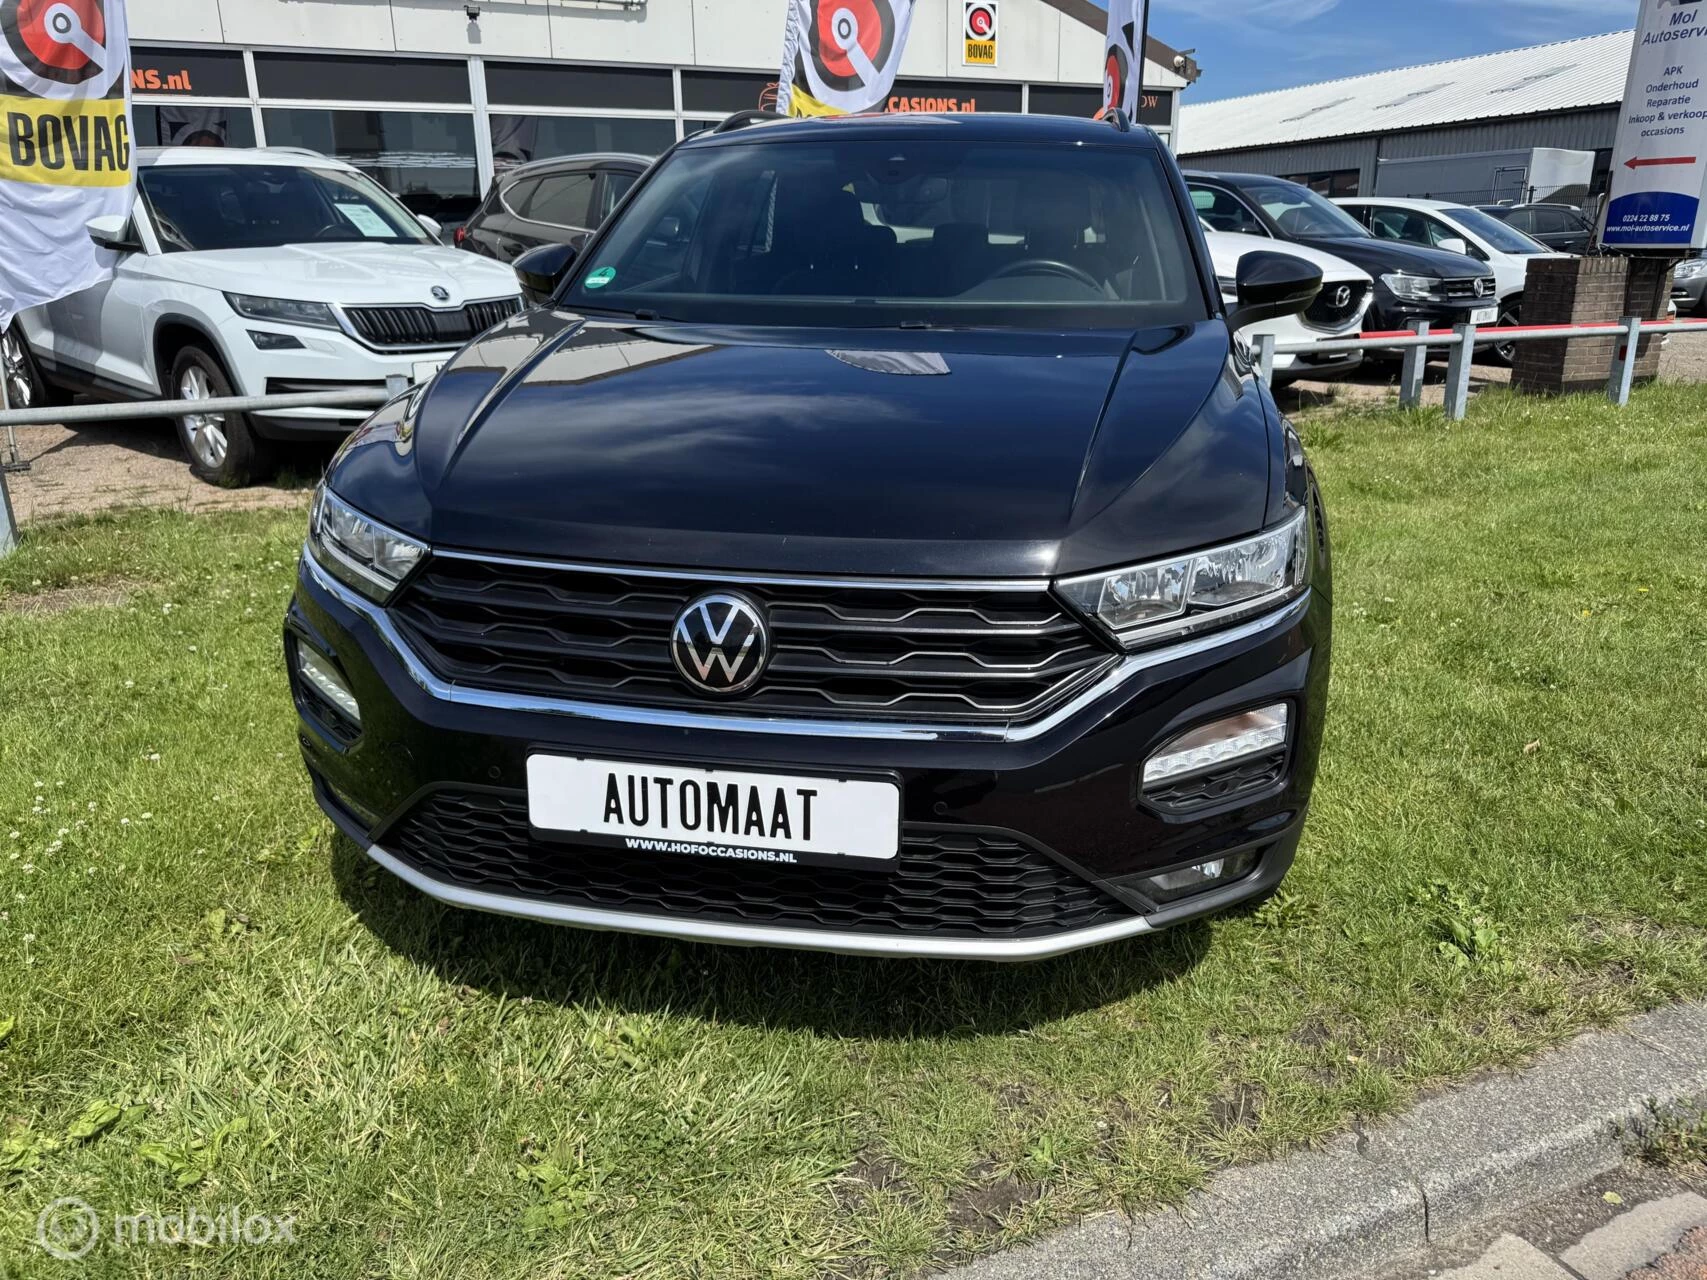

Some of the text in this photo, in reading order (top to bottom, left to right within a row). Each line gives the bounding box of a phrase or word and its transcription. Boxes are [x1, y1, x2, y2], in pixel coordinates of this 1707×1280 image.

[1669, 9, 1698, 26] Mol
[967, 43, 993, 60] BOVAG
[1663, 65, 1684, 77] APK
[1645, 79, 1700, 94] Onderhoud
[1646, 95, 1691, 109] Reparatie
[1628, 114, 1656, 125] Inkoop
[1657, 112, 1665, 121] &
[1640, 126, 1685, 137] occasions
[7, 111, 130, 172] BOVAG
[1622, 213, 1671, 222] 0224 22 88 75
[1606, 223, 1690, 233] www.mol-autoservice.nl
[603, 772, 818, 841] AUTOMAAT
[625, 837, 798, 864] WWW.HOFOCCASIONS.NL
